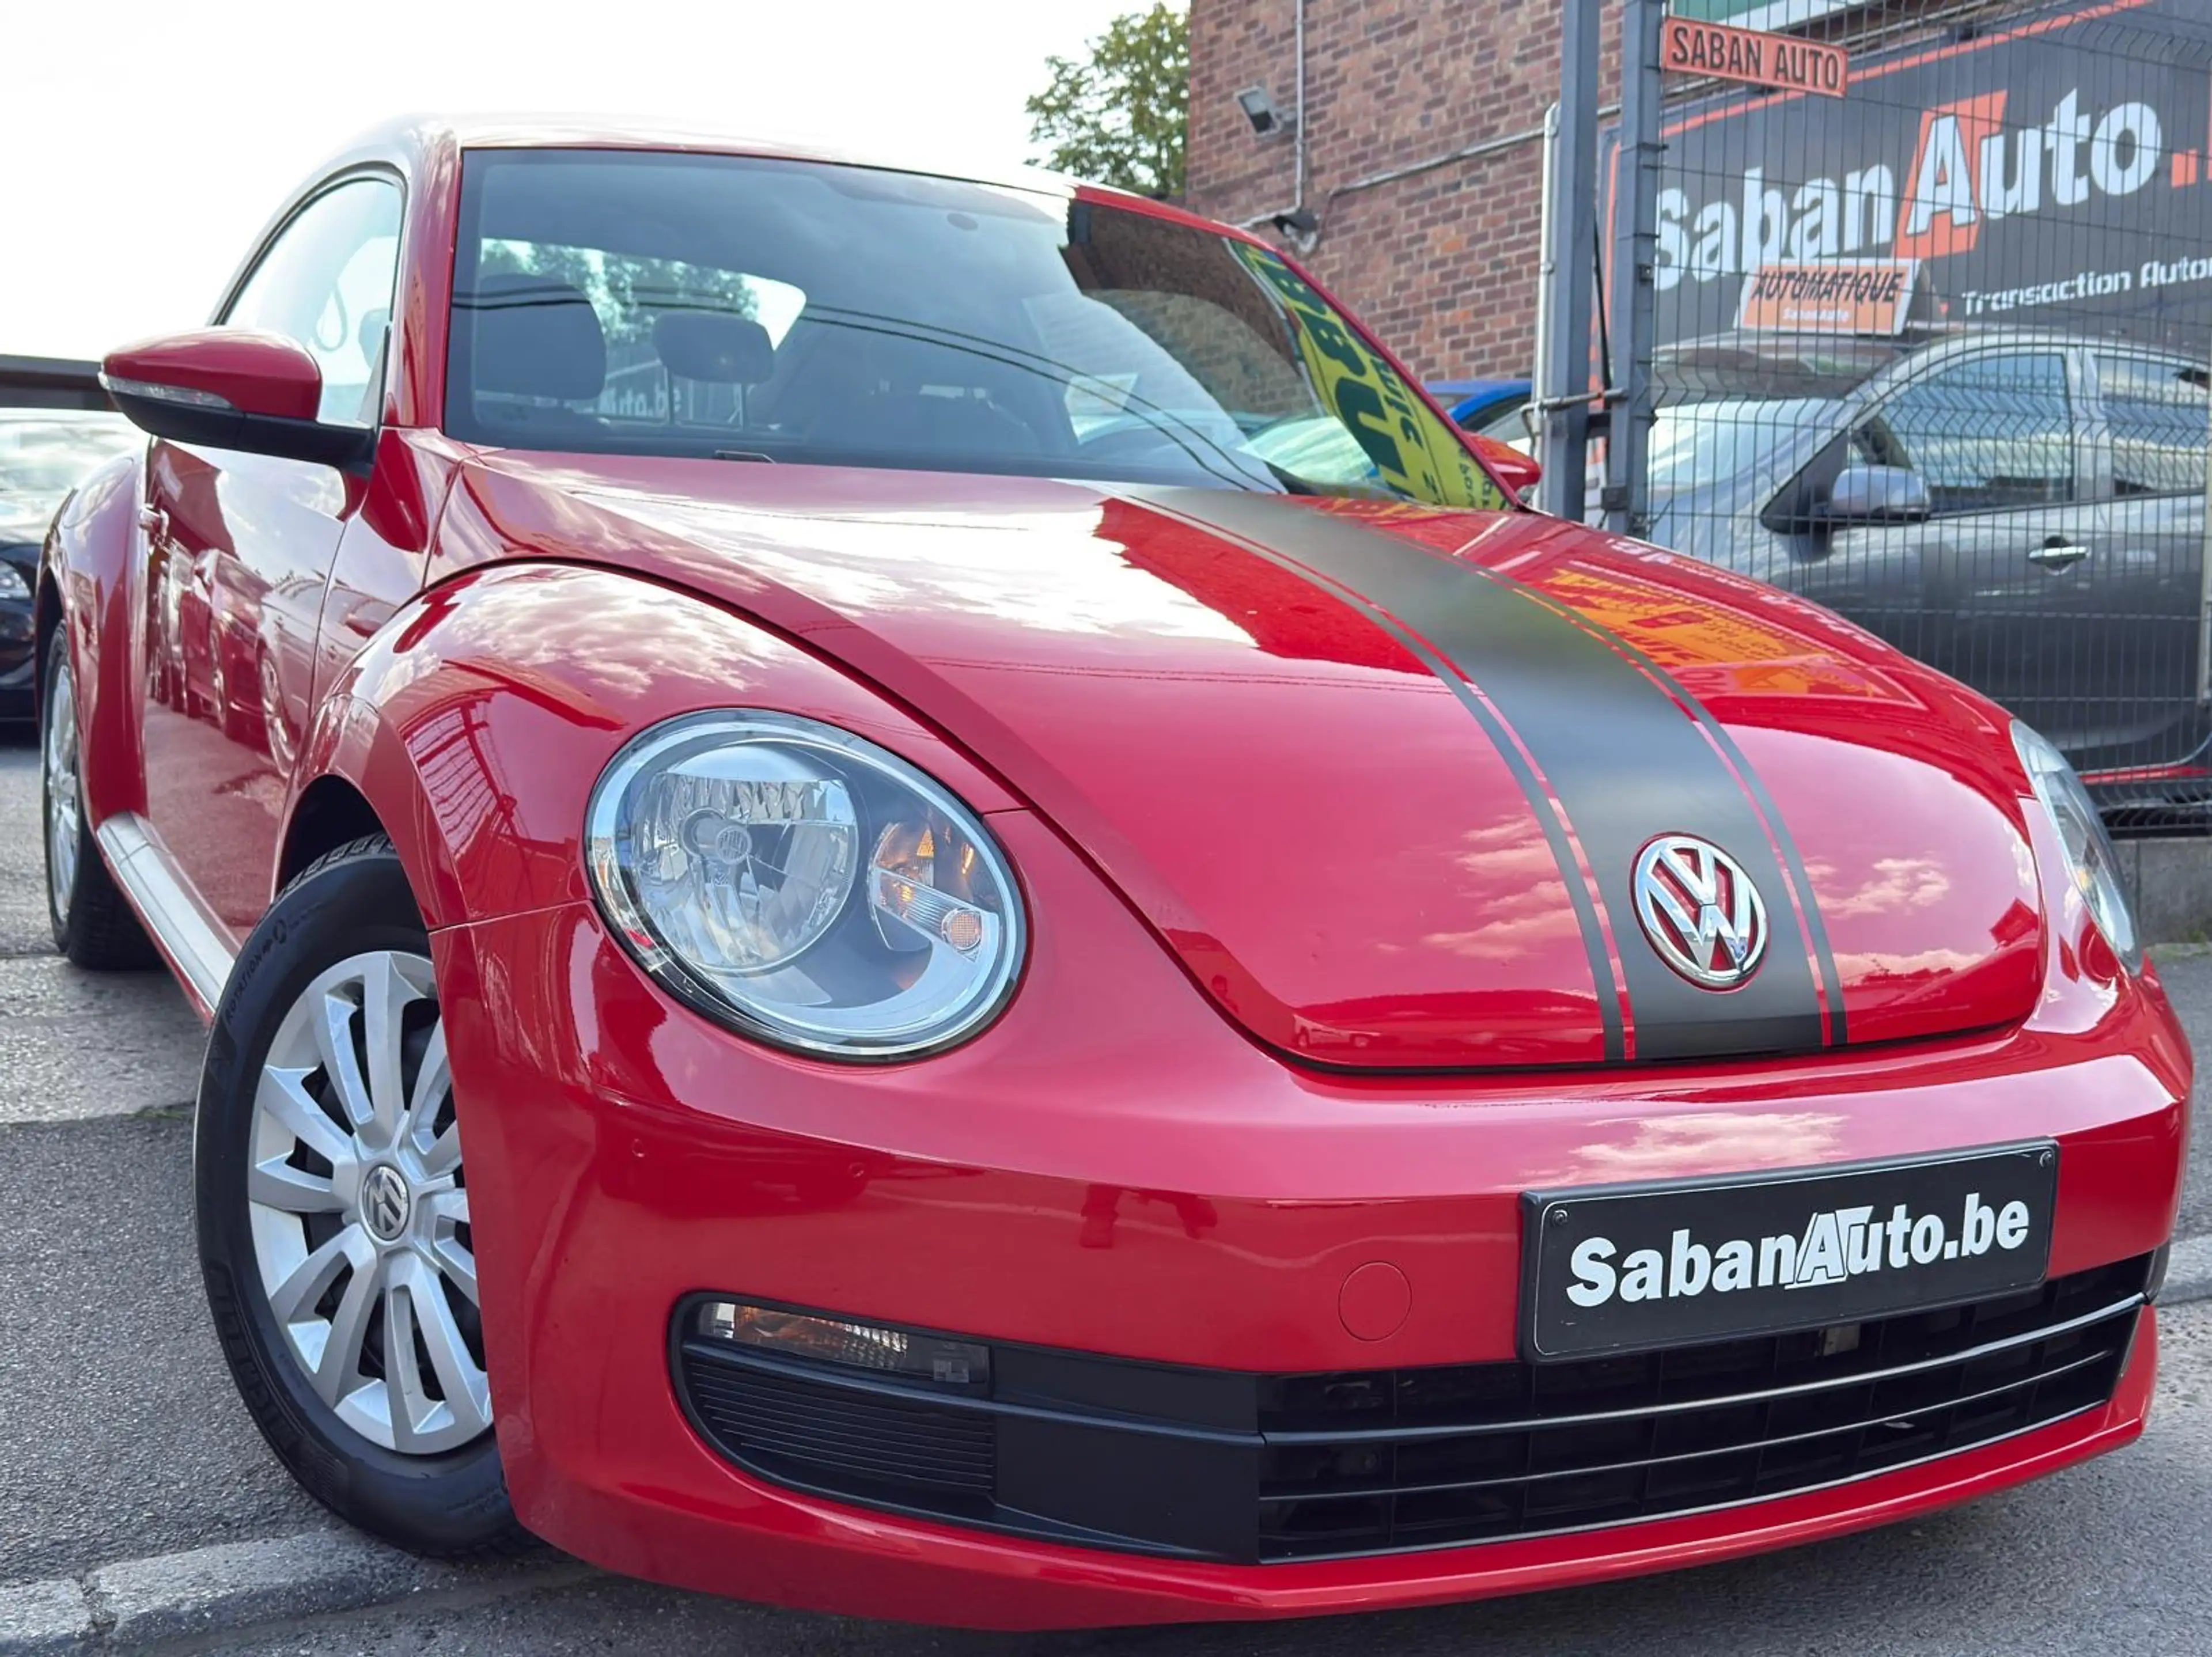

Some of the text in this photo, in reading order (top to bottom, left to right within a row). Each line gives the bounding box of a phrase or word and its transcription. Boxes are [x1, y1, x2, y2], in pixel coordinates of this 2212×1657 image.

[1672, 26, 1839, 89] SABAN AUTO
[1653, 74, 2212, 291] SabanAuto.
[1751, 271, 1903, 305] AUTOMATIQUE
[1961, 256, 2212, 316] Transaction Auto
[1565, 1192, 2029, 1307] SabanAuto.be
